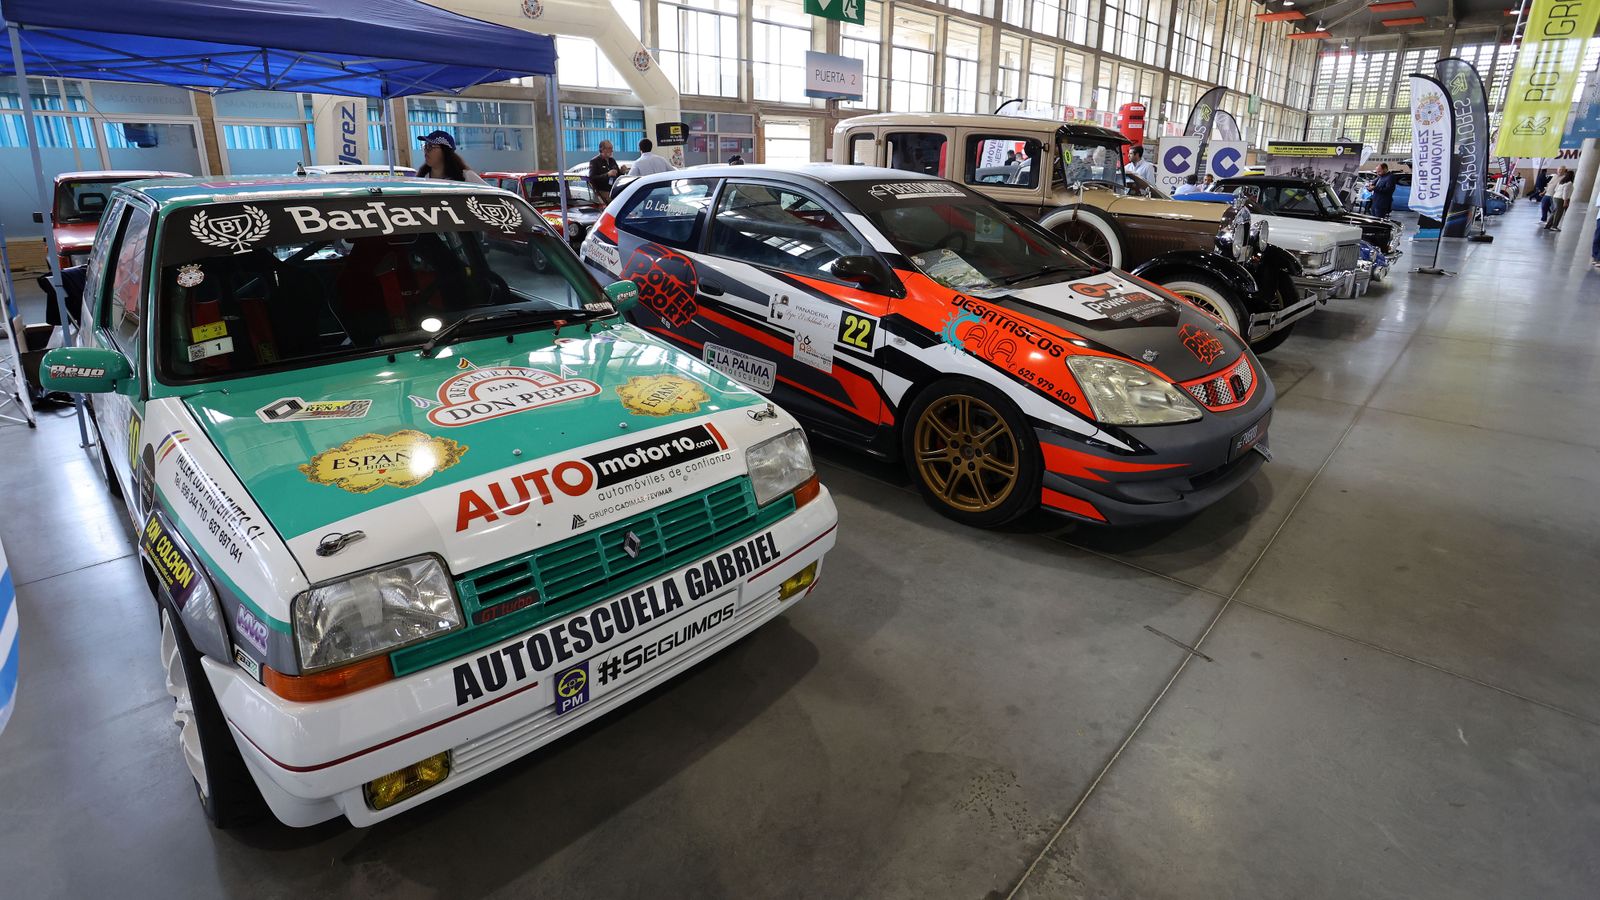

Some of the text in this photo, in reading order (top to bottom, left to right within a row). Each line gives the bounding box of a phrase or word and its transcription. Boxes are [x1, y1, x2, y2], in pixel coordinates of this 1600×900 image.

[1524, 0, 1582, 102] ROTUGR
[815, 67, 857, 87] PUERTA 2
[994, 140, 1004, 164] JERE
[283, 200, 465, 235] BarJavi
[485, 206, 504, 219] BJ
[645, 200, 653, 210] D.
[217, 218, 243, 235] BJ
[633, 277, 687, 328] SPORT
[842, 315, 871, 349] 22
[951, 294, 1065, 358] DESATASCOS
[215, 342, 222, 351] 1
[450, 367, 552, 399] RESTAURANTE
[716, 352, 770, 380] LA PALMA
[446, 383, 588, 421] DON PEPE
[487, 382, 518, 393] BAR
[1017, 368, 1077, 406] 625 979 400
[129, 415, 140, 470] 10
[332, 450, 412, 471] ESPAÑ
[598, 452, 732, 502] automóviles de confianza
[456, 436, 714, 533] AUTO motor10.com
[181, 482, 190, 500] 956
[189, 493, 199, 511] 344
[198, 504, 208, 522] 710
[208, 517, 220, 536] 637
[218, 528, 232, 549] 697
[229, 545, 243, 564] 041
[589, 506, 614, 520] GRUPO
[146, 517, 163, 544] DON
[156, 535, 195, 589] COLCHON
[452, 531, 782, 707] AUTOESCUELA GABRIEL
[481, 607, 497, 623] GT
[596, 602, 736, 687] #SEGUIMOS
[561, 692, 585, 712] PM
